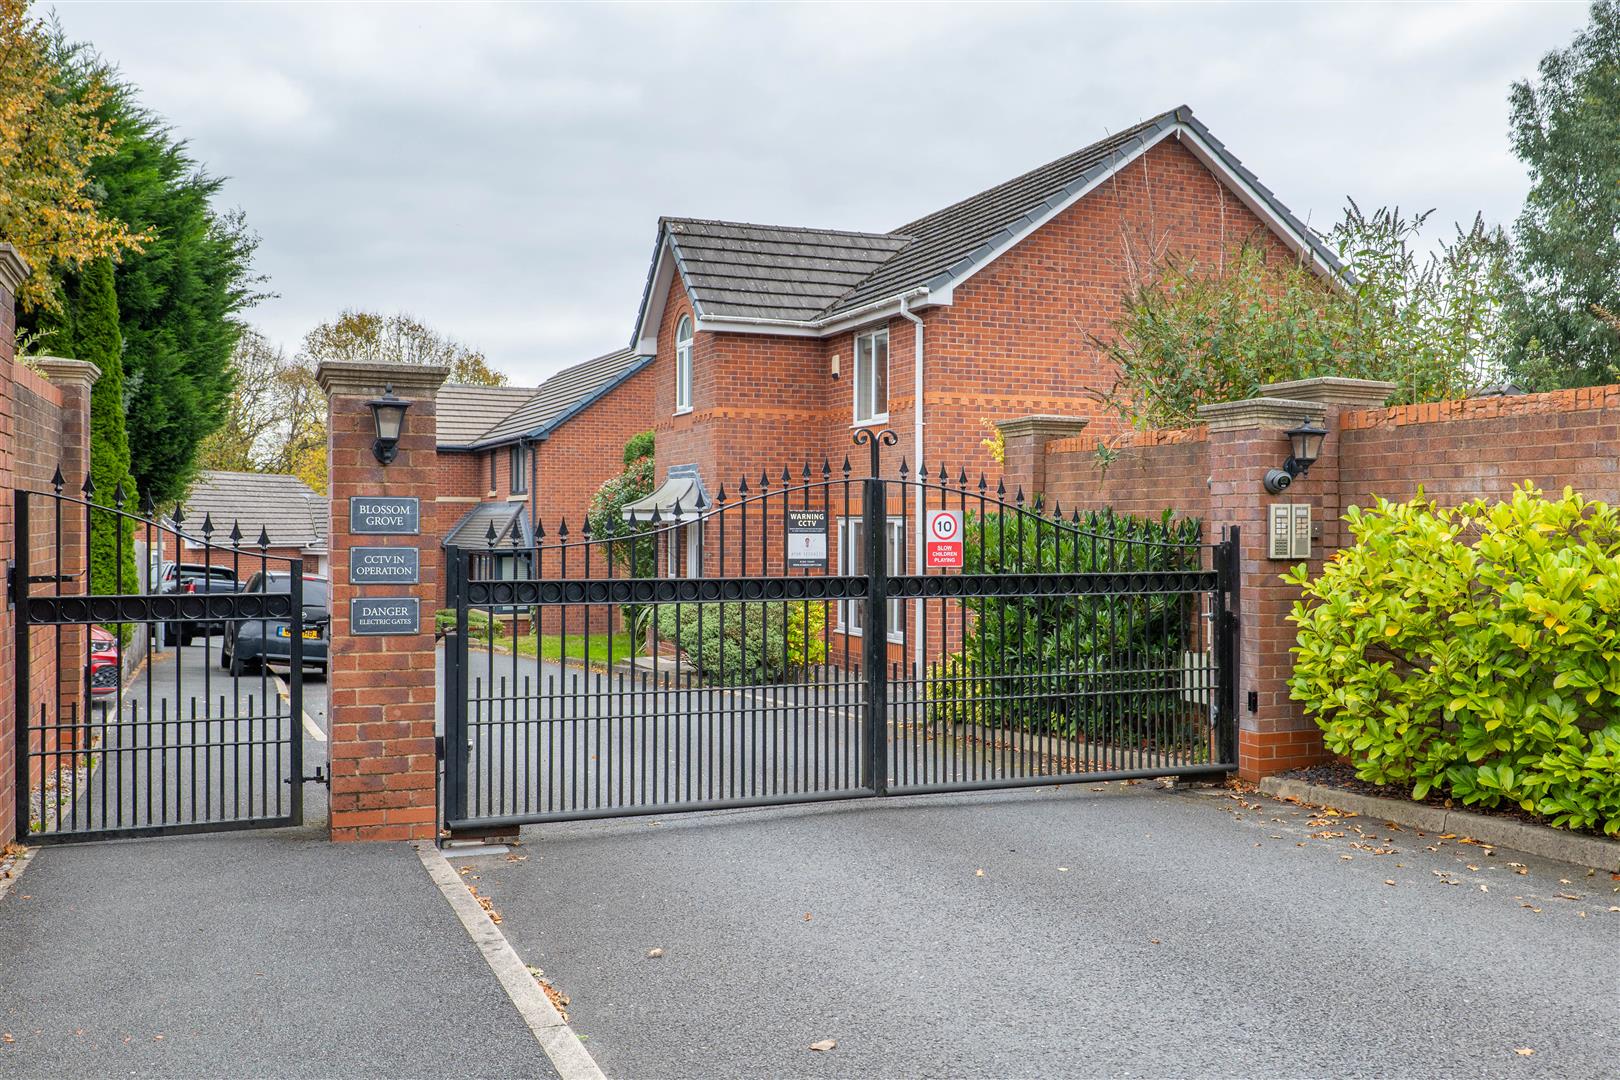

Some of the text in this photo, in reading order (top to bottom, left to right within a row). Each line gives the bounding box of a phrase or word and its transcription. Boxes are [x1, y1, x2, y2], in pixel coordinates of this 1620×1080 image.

[360, 505, 410, 514] BLOSSOM
[366, 516, 404, 526] GROVE
[938, 521, 952, 532] 10
[364, 556, 404, 564] CCTV IN
[356, 567, 412, 575] OPERATION
[362, 607, 409, 616] DANGER
